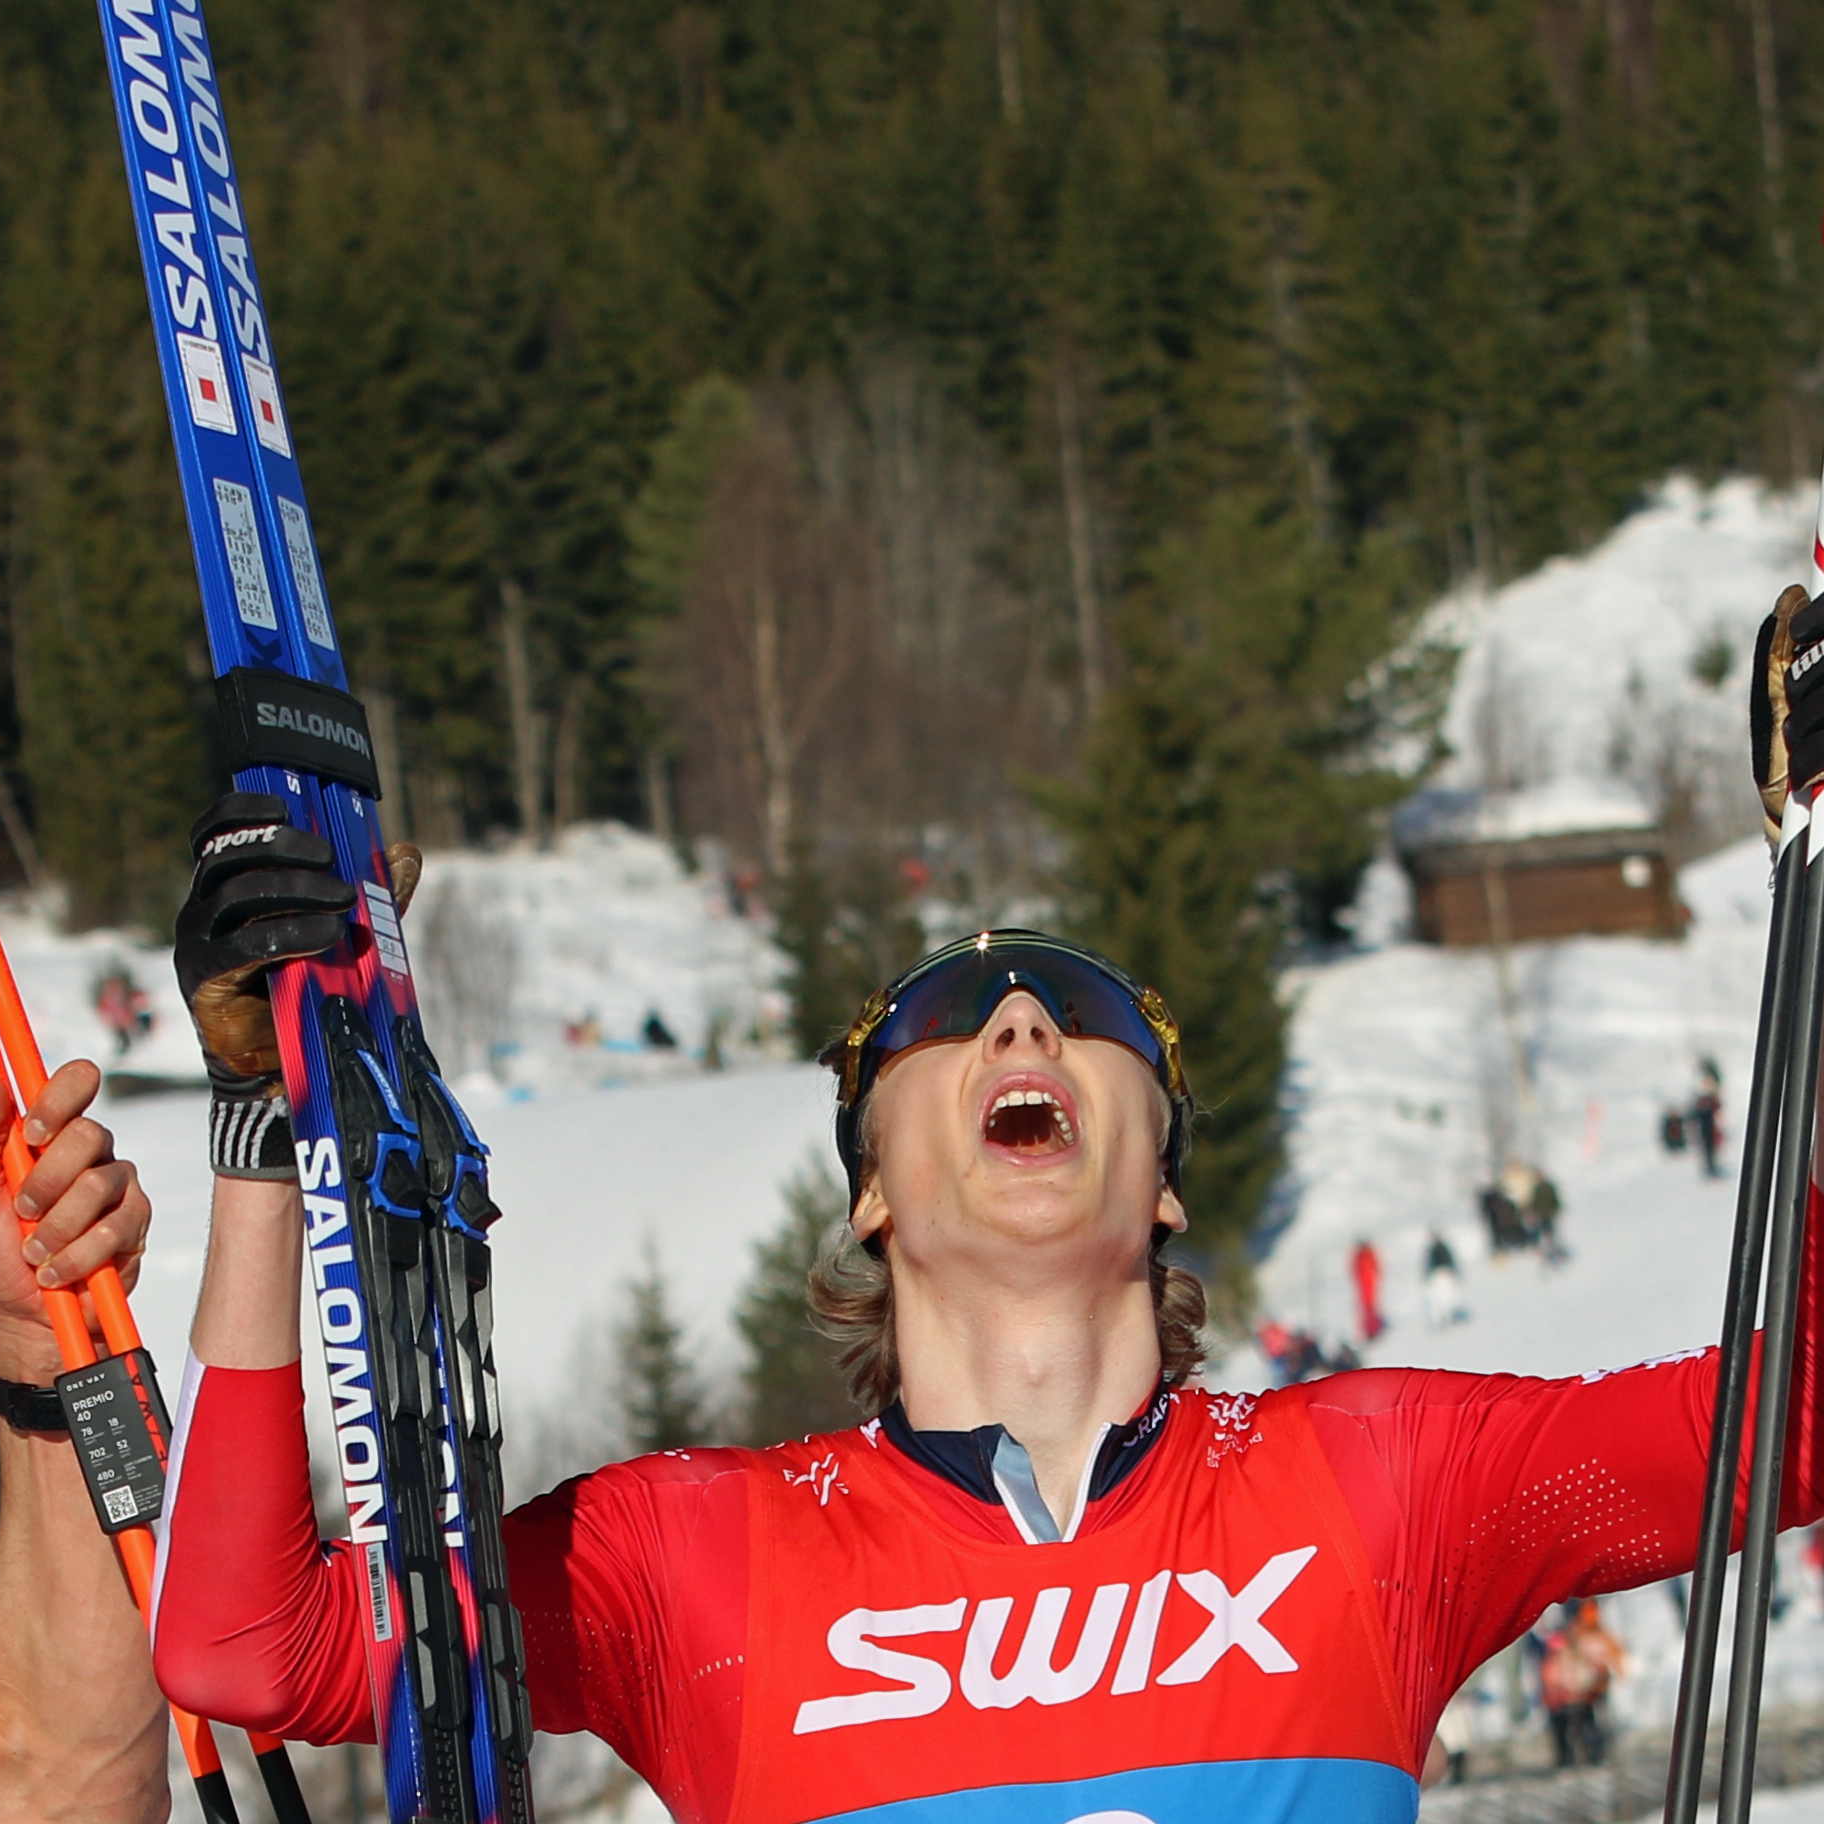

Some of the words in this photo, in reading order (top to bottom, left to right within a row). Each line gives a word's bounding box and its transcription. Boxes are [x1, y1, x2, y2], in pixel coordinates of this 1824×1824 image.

[113, 0, 218, 342] SALOM
[171, 0, 271, 366] SALOM
[256, 702, 373, 763] SALOMON
[294, 1136, 389, 1544] SALOMON
[72, 1389, 115, 1413] PREMIO
[76, 1410, 92, 1423] 40
[81, 1426, 94, 1438] 78
[88, 1446, 107, 1460] 702
[116, 1438, 129, 1451] 52
[96, 1468, 116, 1482] 480
[792, 1545, 1319, 1735] SWIX
